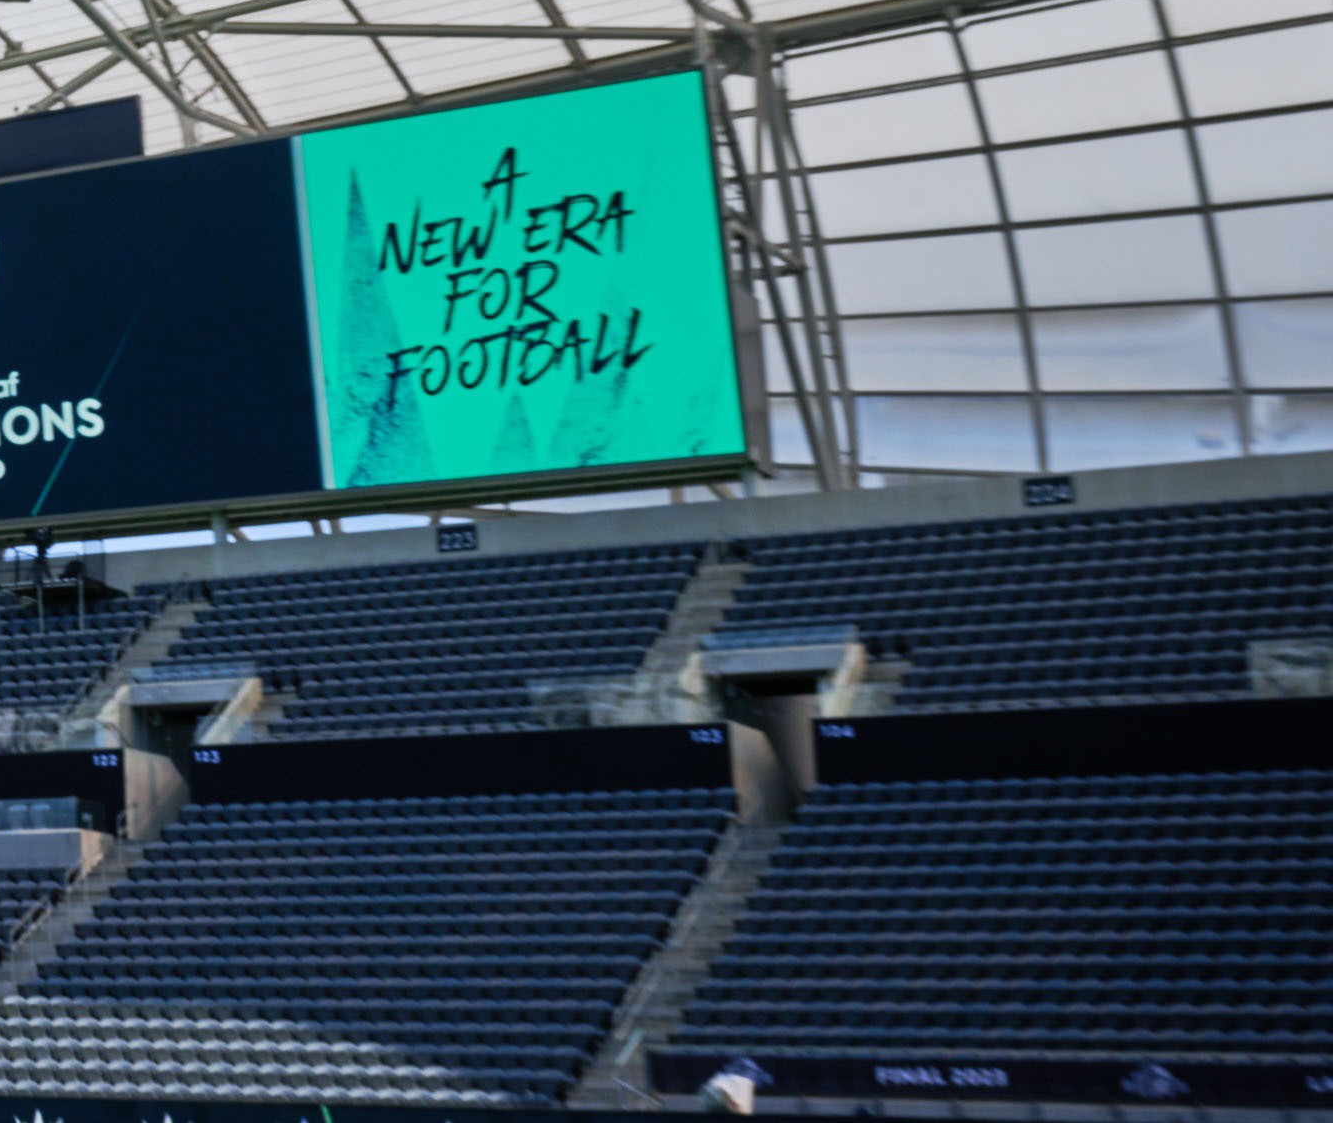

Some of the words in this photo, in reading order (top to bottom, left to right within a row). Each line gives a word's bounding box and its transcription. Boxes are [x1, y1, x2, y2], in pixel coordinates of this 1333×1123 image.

[483, 147, 530, 222] A
[378, 196, 498, 274] NEW
[524, 190, 635, 256] ERA
[444, 259, 560, 334] FOR
[384, 307, 655, 413] FOOTBALL
